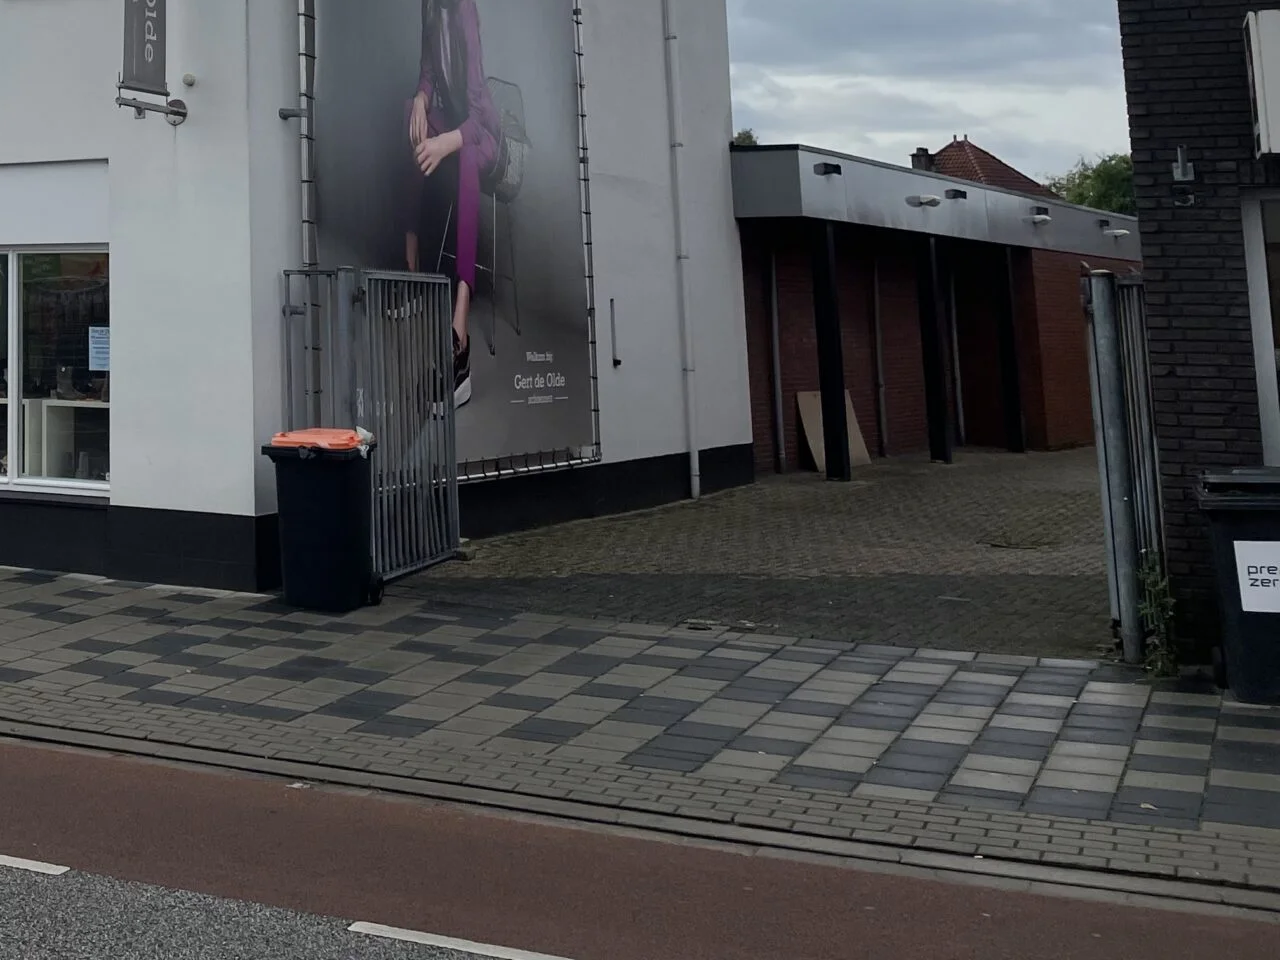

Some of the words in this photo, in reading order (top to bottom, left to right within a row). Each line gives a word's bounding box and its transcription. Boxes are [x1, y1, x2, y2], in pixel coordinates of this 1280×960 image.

[514, 374, 533, 389] Gert
[534, 373, 545, 388] de
[546, 372, 566, 387] Olde
[1247, 565, 1278, 576] pre
[1248, 578, 1280, 588] zer
